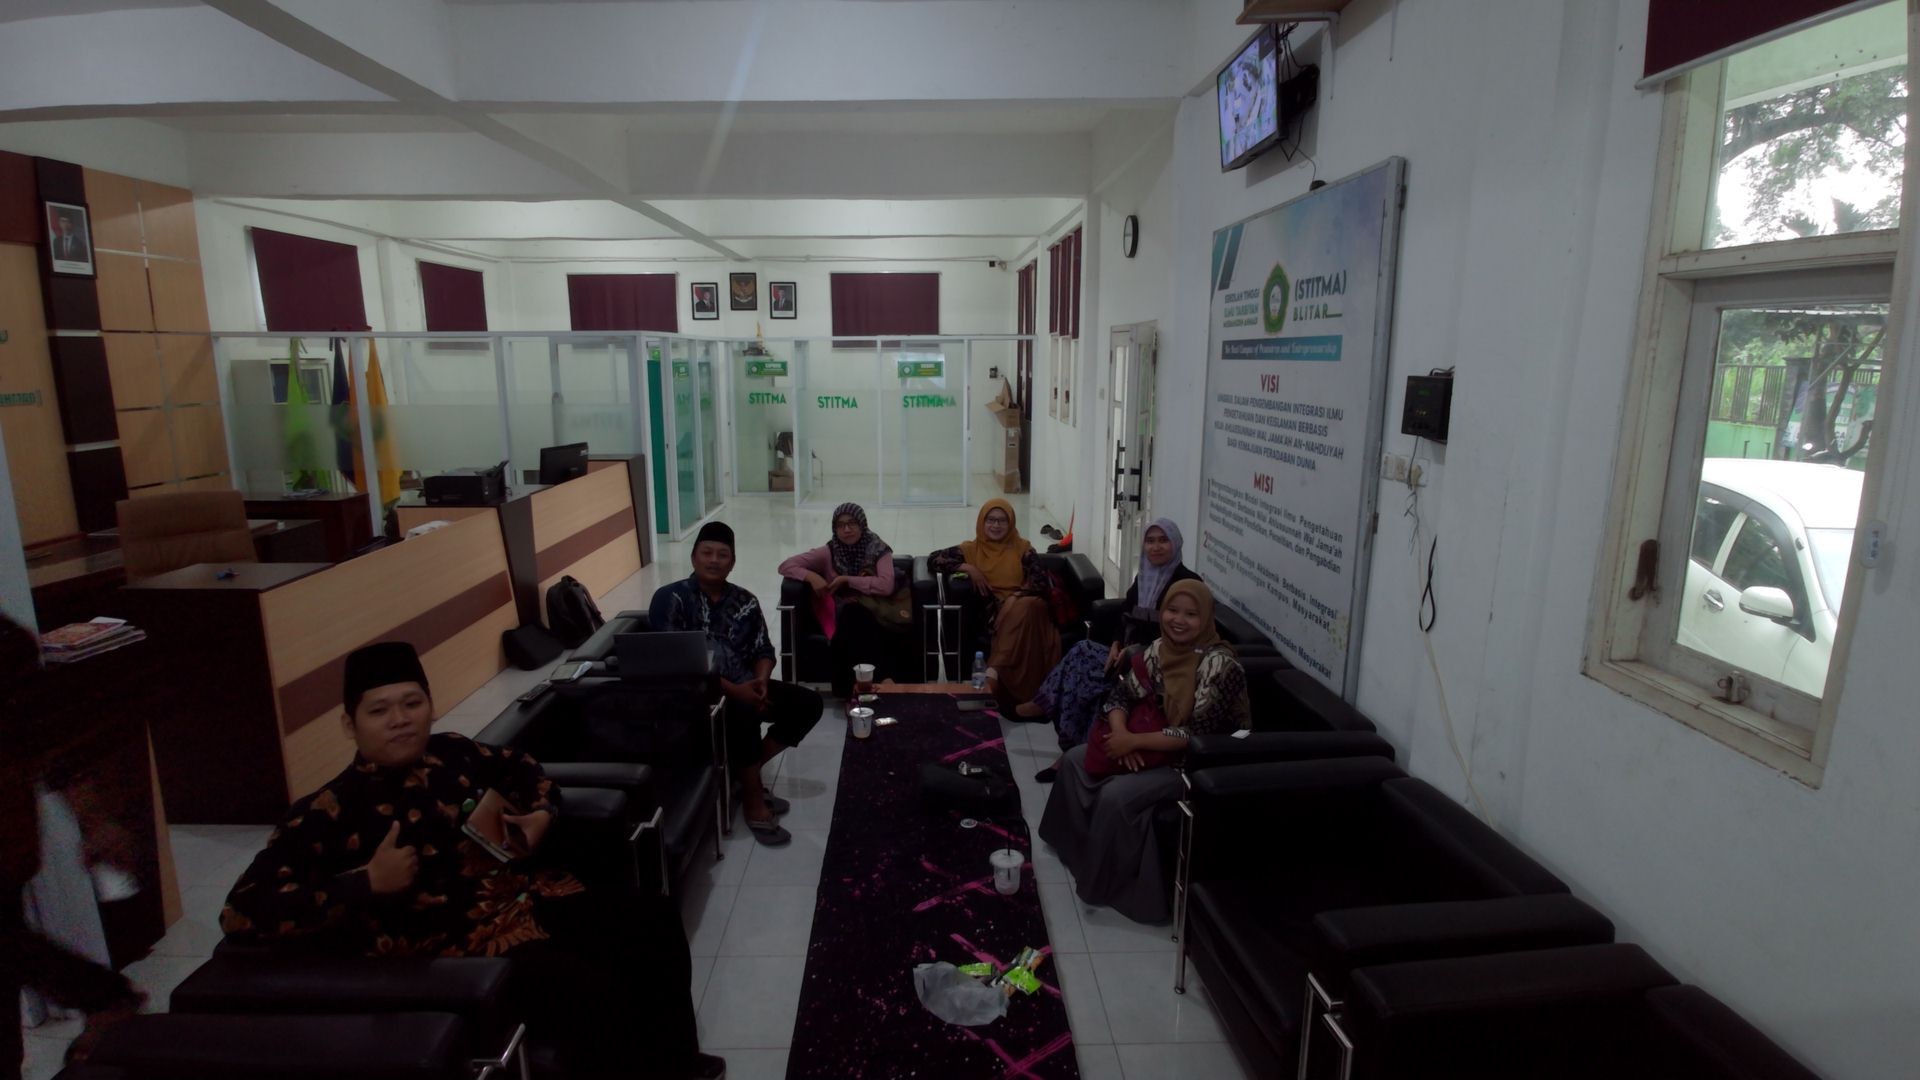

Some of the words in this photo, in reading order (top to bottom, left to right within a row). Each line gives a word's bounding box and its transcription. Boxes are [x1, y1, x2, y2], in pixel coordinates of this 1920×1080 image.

[1295, 269, 1347, 302] (STITMA)
[1293, 302, 1328, 321] BLITAR
[1260, 373, 1280, 393] VISI
[749, 392, 787, 405] STITMA
[817, 396, 858, 409] STITMA
[1250, 397, 1292, 414] PENGEMBANGAN
[1292, 403, 1325, 419] INTEGRASI
[1326, 407, 1344, 421] ILMU
[1224, 407, 1255, 421] PENGETAHUAN
[1255, 413, 1266, 425] DAN
[1266, 415, 1297, 432] KEISLAMAN
[1298, 420, 1329, 438] BERBASIS
[1263, 446, 1296, 465] PERADABAN
[1296, 455, 1317, 471] DUNIA
[1293, 437, 1344, 460] AN-NAHDLIYAH
[1254, 472, 1274, 495] MISI
[1299, 515, 1344, 543] Pengetahuan
[1305, 547, 1341, 576] Pengabdian
[1282, 577, 1307, 601] Berbasis
[1310, 595, 1338, 621] Integrasi
